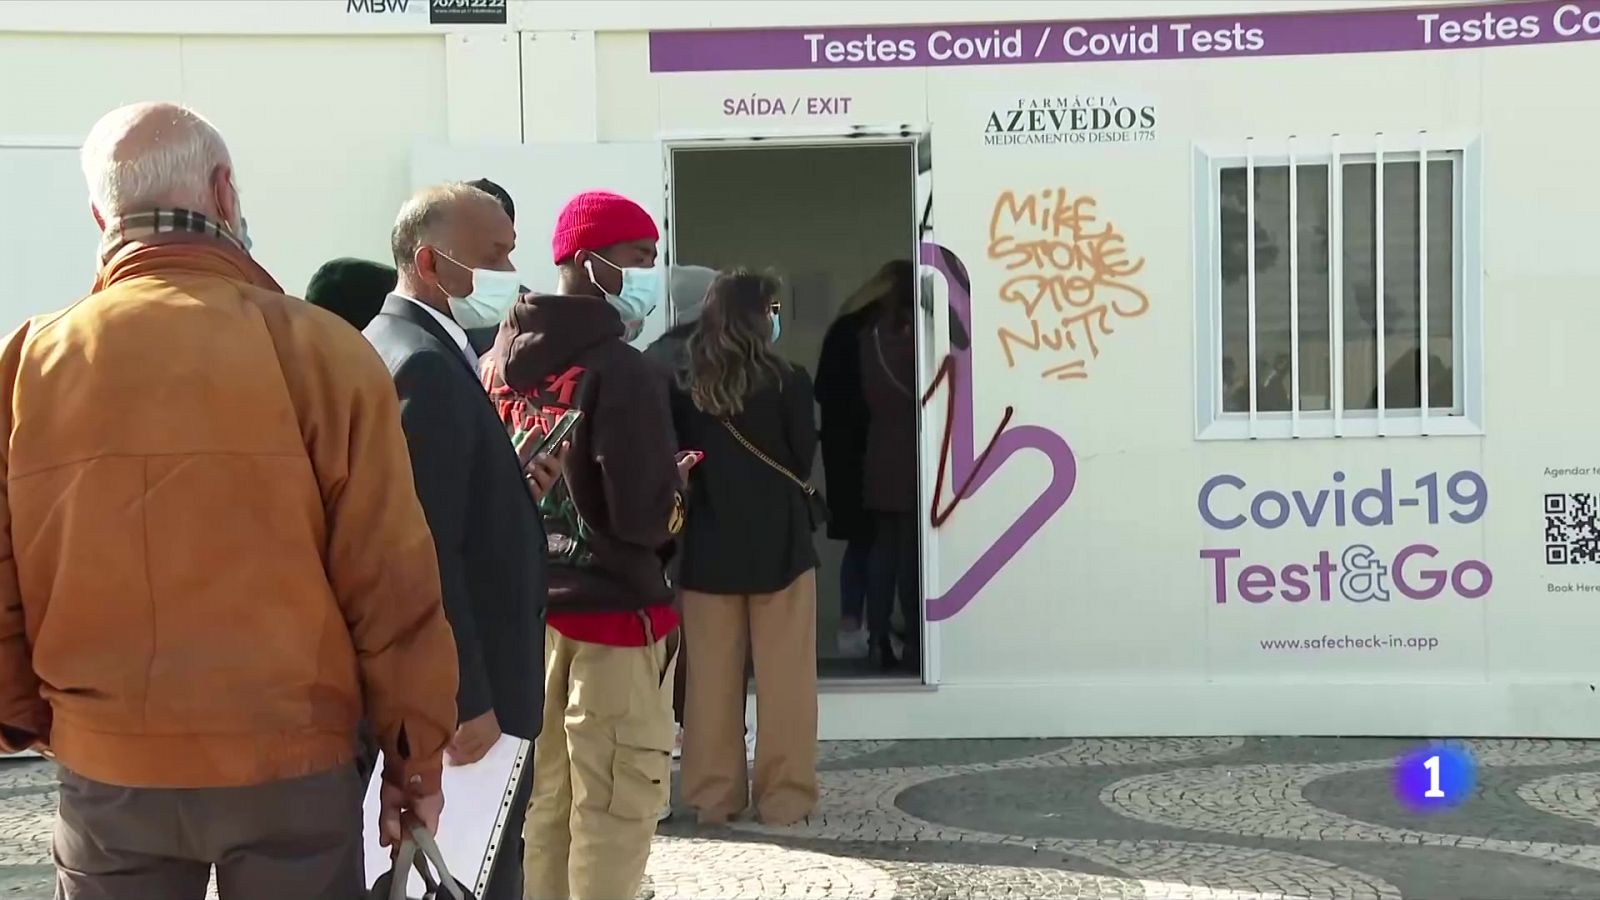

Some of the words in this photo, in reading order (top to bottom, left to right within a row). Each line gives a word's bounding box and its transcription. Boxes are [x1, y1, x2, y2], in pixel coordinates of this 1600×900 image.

[347, 0, 409, 13] MBW
[1416, 11, 1540, 44] Testes
[1553, 4, 1600, 37] Co
[804, 33, 917, 63] Testes
[927, 28, 1022, 61] Covid
[1034, 26, 1051, 58] /
[1062, 25, 1158, 56] Covid
[1169, 22, 1265, 53] Tests
[723, 93, 786, 115] SAÍDA
[791, 97, 801, 115] /
[807, 97, 852, 115] EXIT
[1018, 95, 1118, 109] FARMÁCIA
[984, 105, 1156, 134] AZEVEDOS
[984, 132, 1086, 146] MEDICAMENTOS
[1088, 131, 1130, 143] DESDE
[1133, 130, 1156, 142] 1775
[1543, 466, 1590, 479] Agendar
[1197, 468, 1489, 530] Covid-19
[1200, 543, 1494, 604] Test&Go
[1547, 581, 1574, 593] Book
[1260, 635, 1440, 651] www.safecheck-in.app
